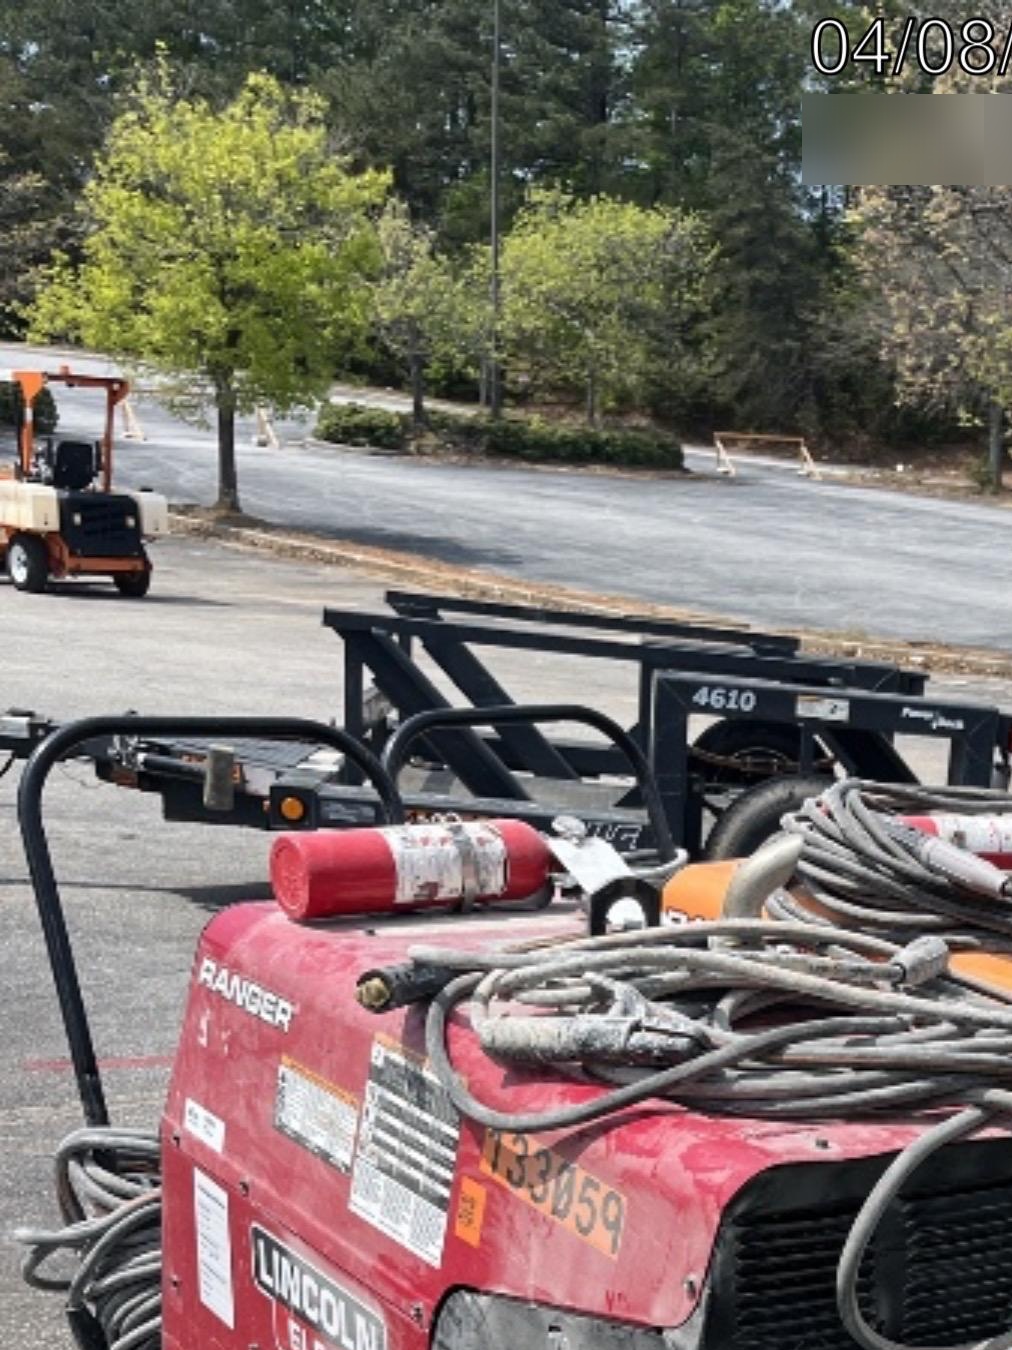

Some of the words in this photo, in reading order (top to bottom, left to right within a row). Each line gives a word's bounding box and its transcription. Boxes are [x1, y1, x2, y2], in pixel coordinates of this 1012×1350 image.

[692, 686, 757, 713] 4610
[199, 956, 294, 1033] RANGER
[488, 1126, 622, 1255] 133059
